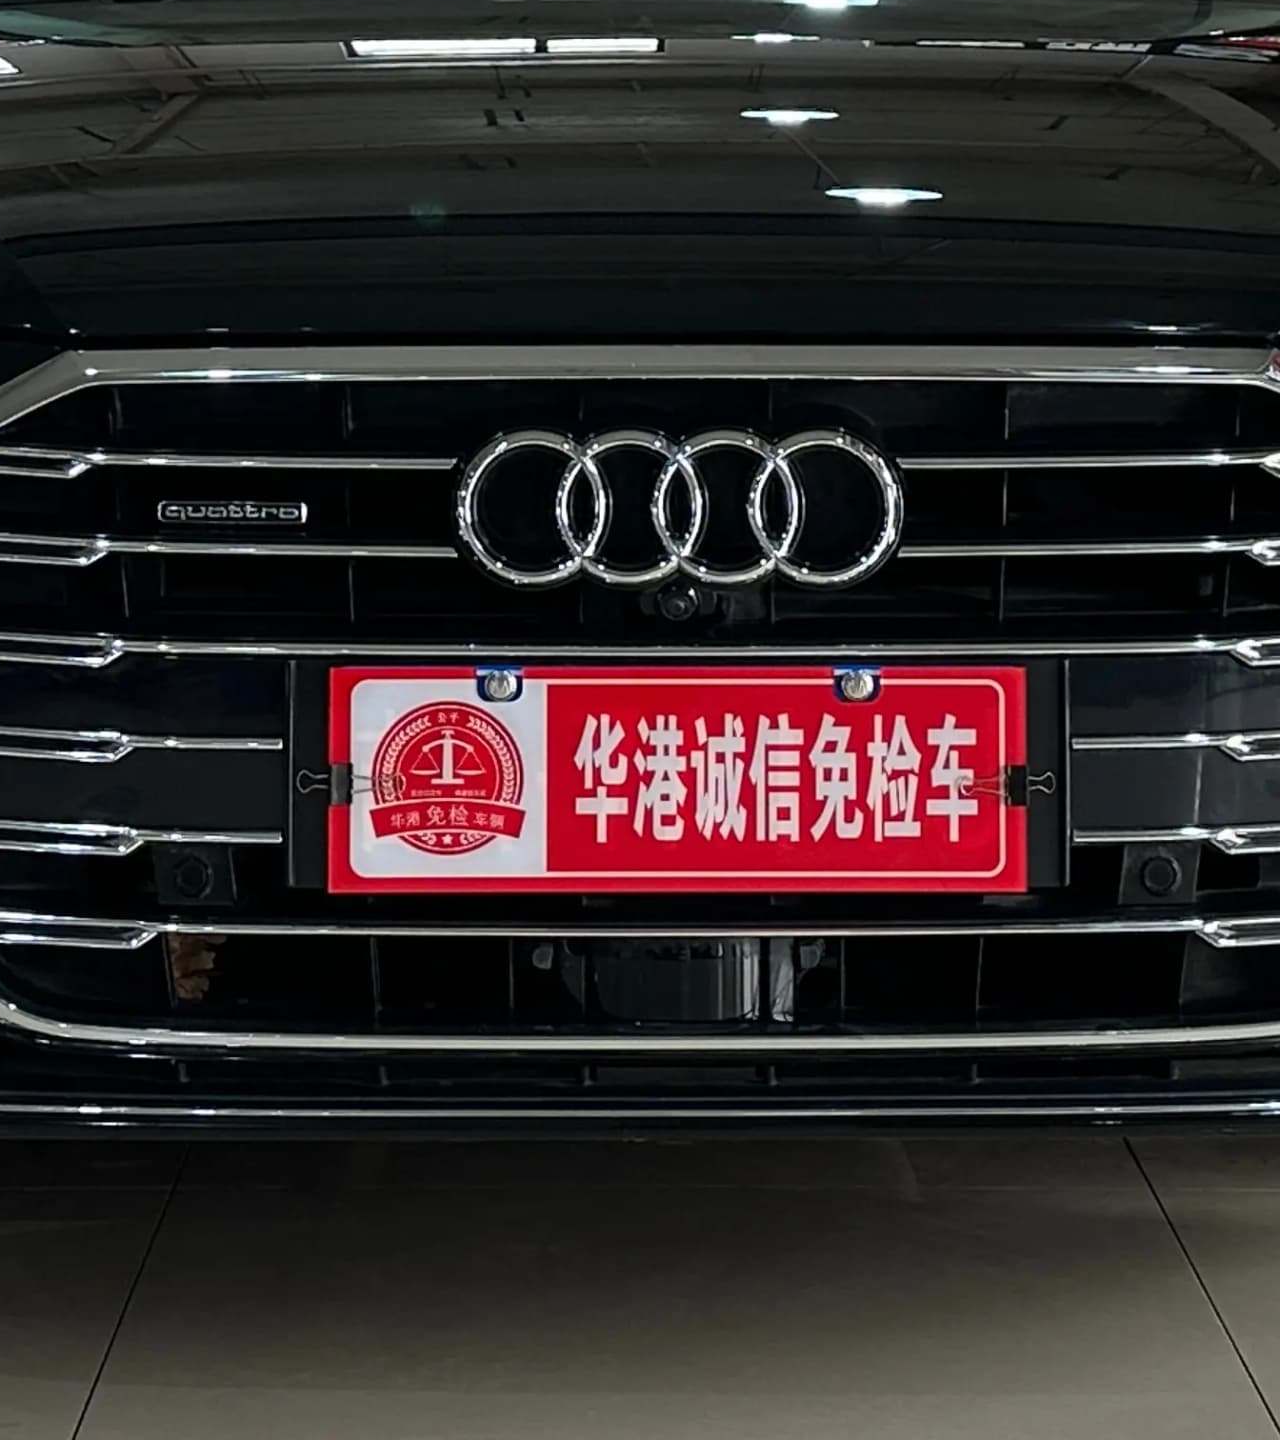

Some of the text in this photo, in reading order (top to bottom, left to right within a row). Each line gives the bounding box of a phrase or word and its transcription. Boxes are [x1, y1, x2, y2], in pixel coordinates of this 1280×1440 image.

[165, 504, 300, 521] quattro
[573, 712, 980, 844] 华港诚信免检车
